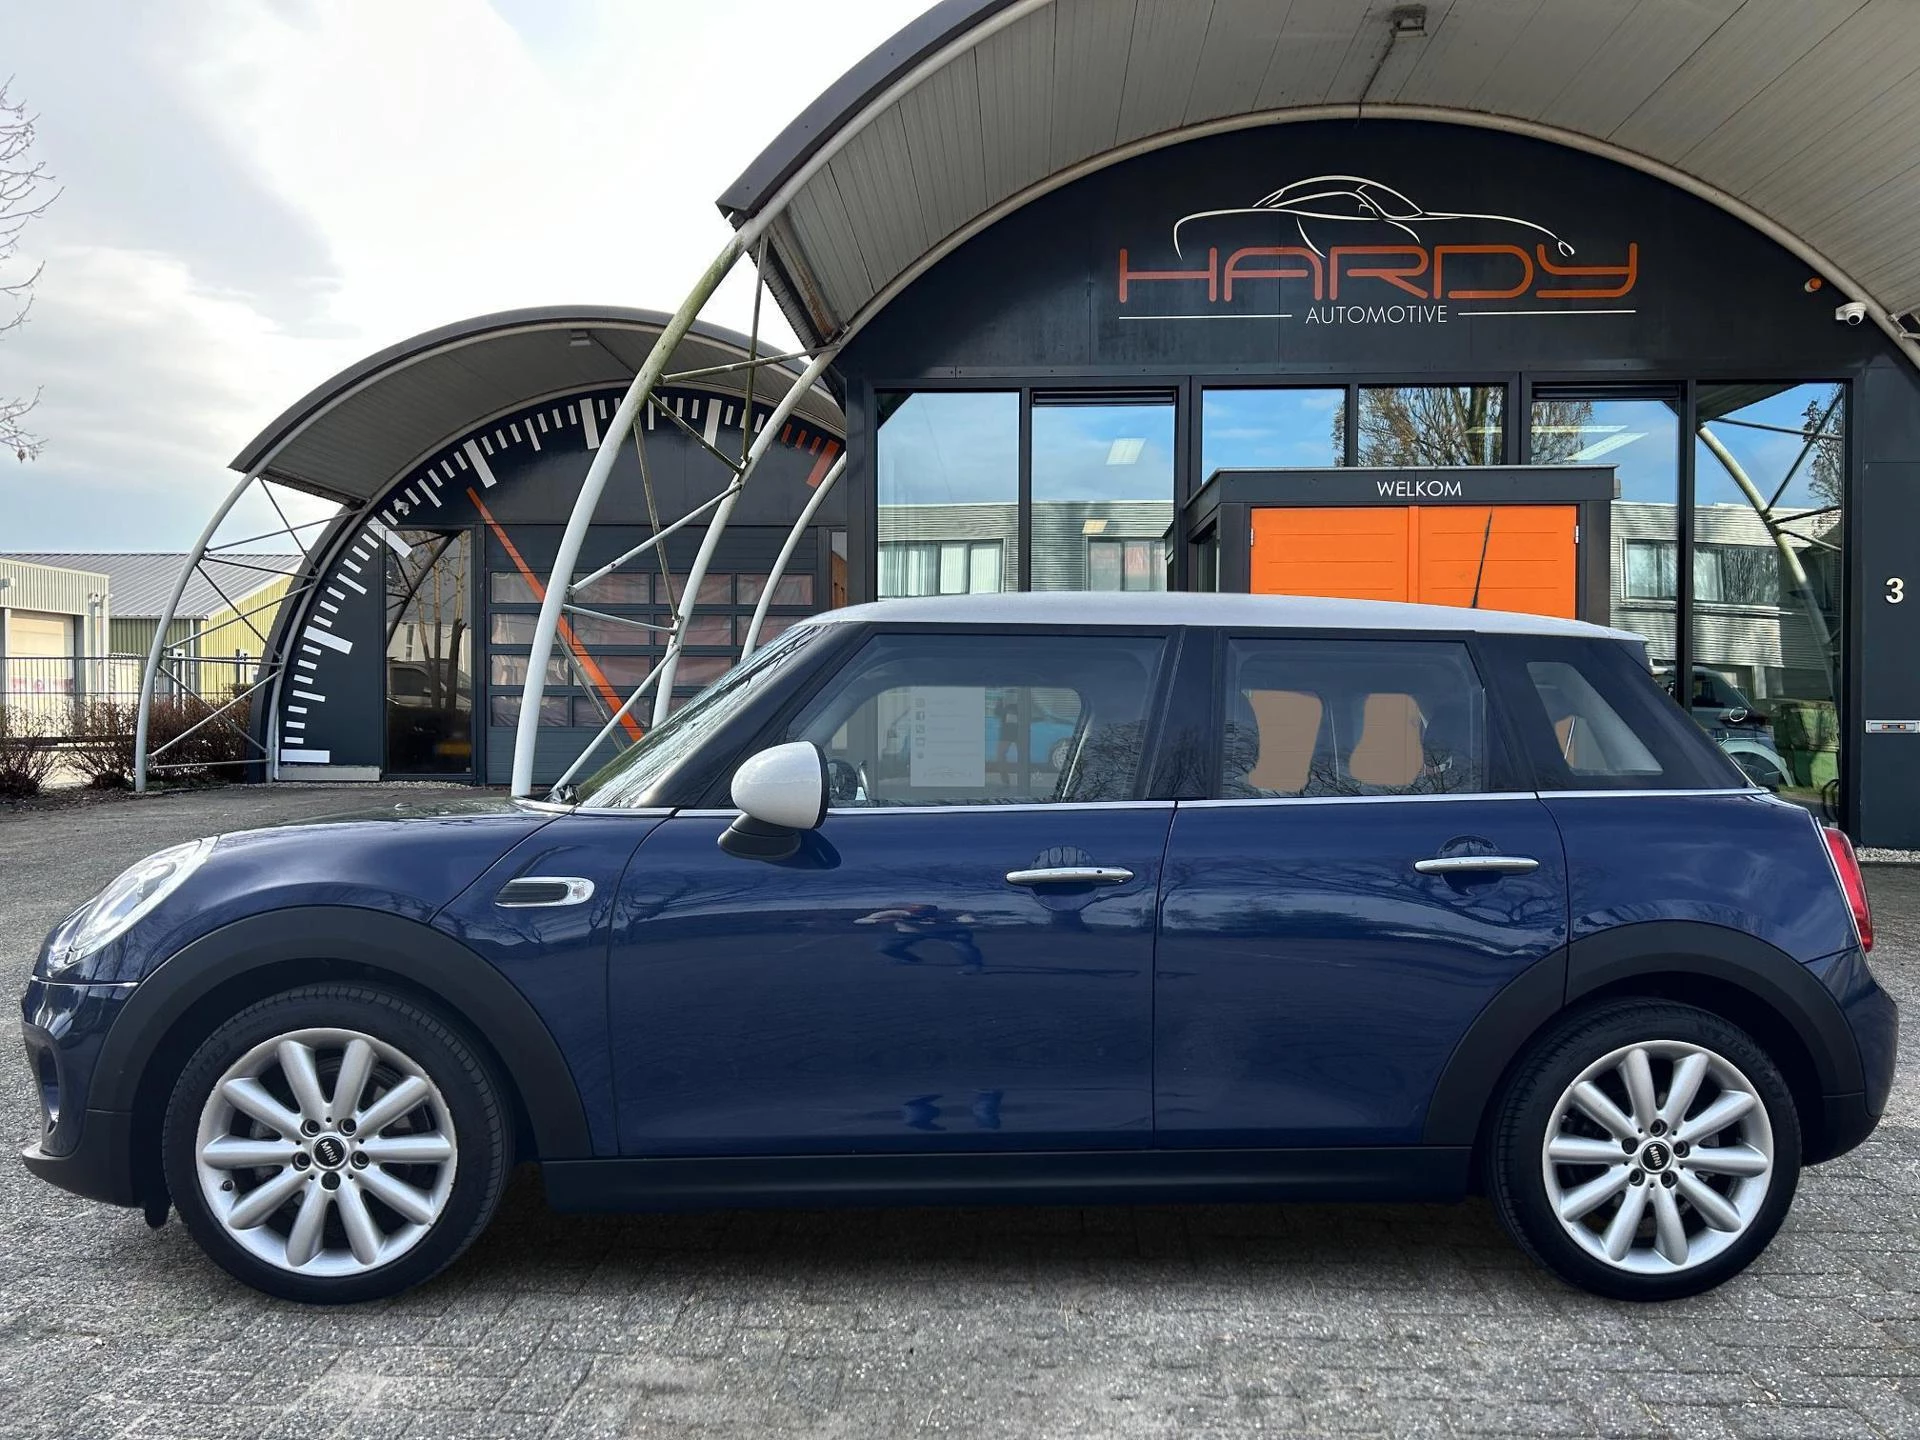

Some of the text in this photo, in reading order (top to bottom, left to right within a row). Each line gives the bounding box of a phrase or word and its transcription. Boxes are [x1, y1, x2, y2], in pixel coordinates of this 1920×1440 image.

[1119, 242, 1637, 302] HARDY
[1305, 305, 1448, 324] AUTOMOTIVE
[1376, 480, 1462, 497] WELKOM
[1885, 577, 1904, 604] 3
[320, 1141, 338, 1163] MINI
[1649, 1146, 1662, 1167] MINI
